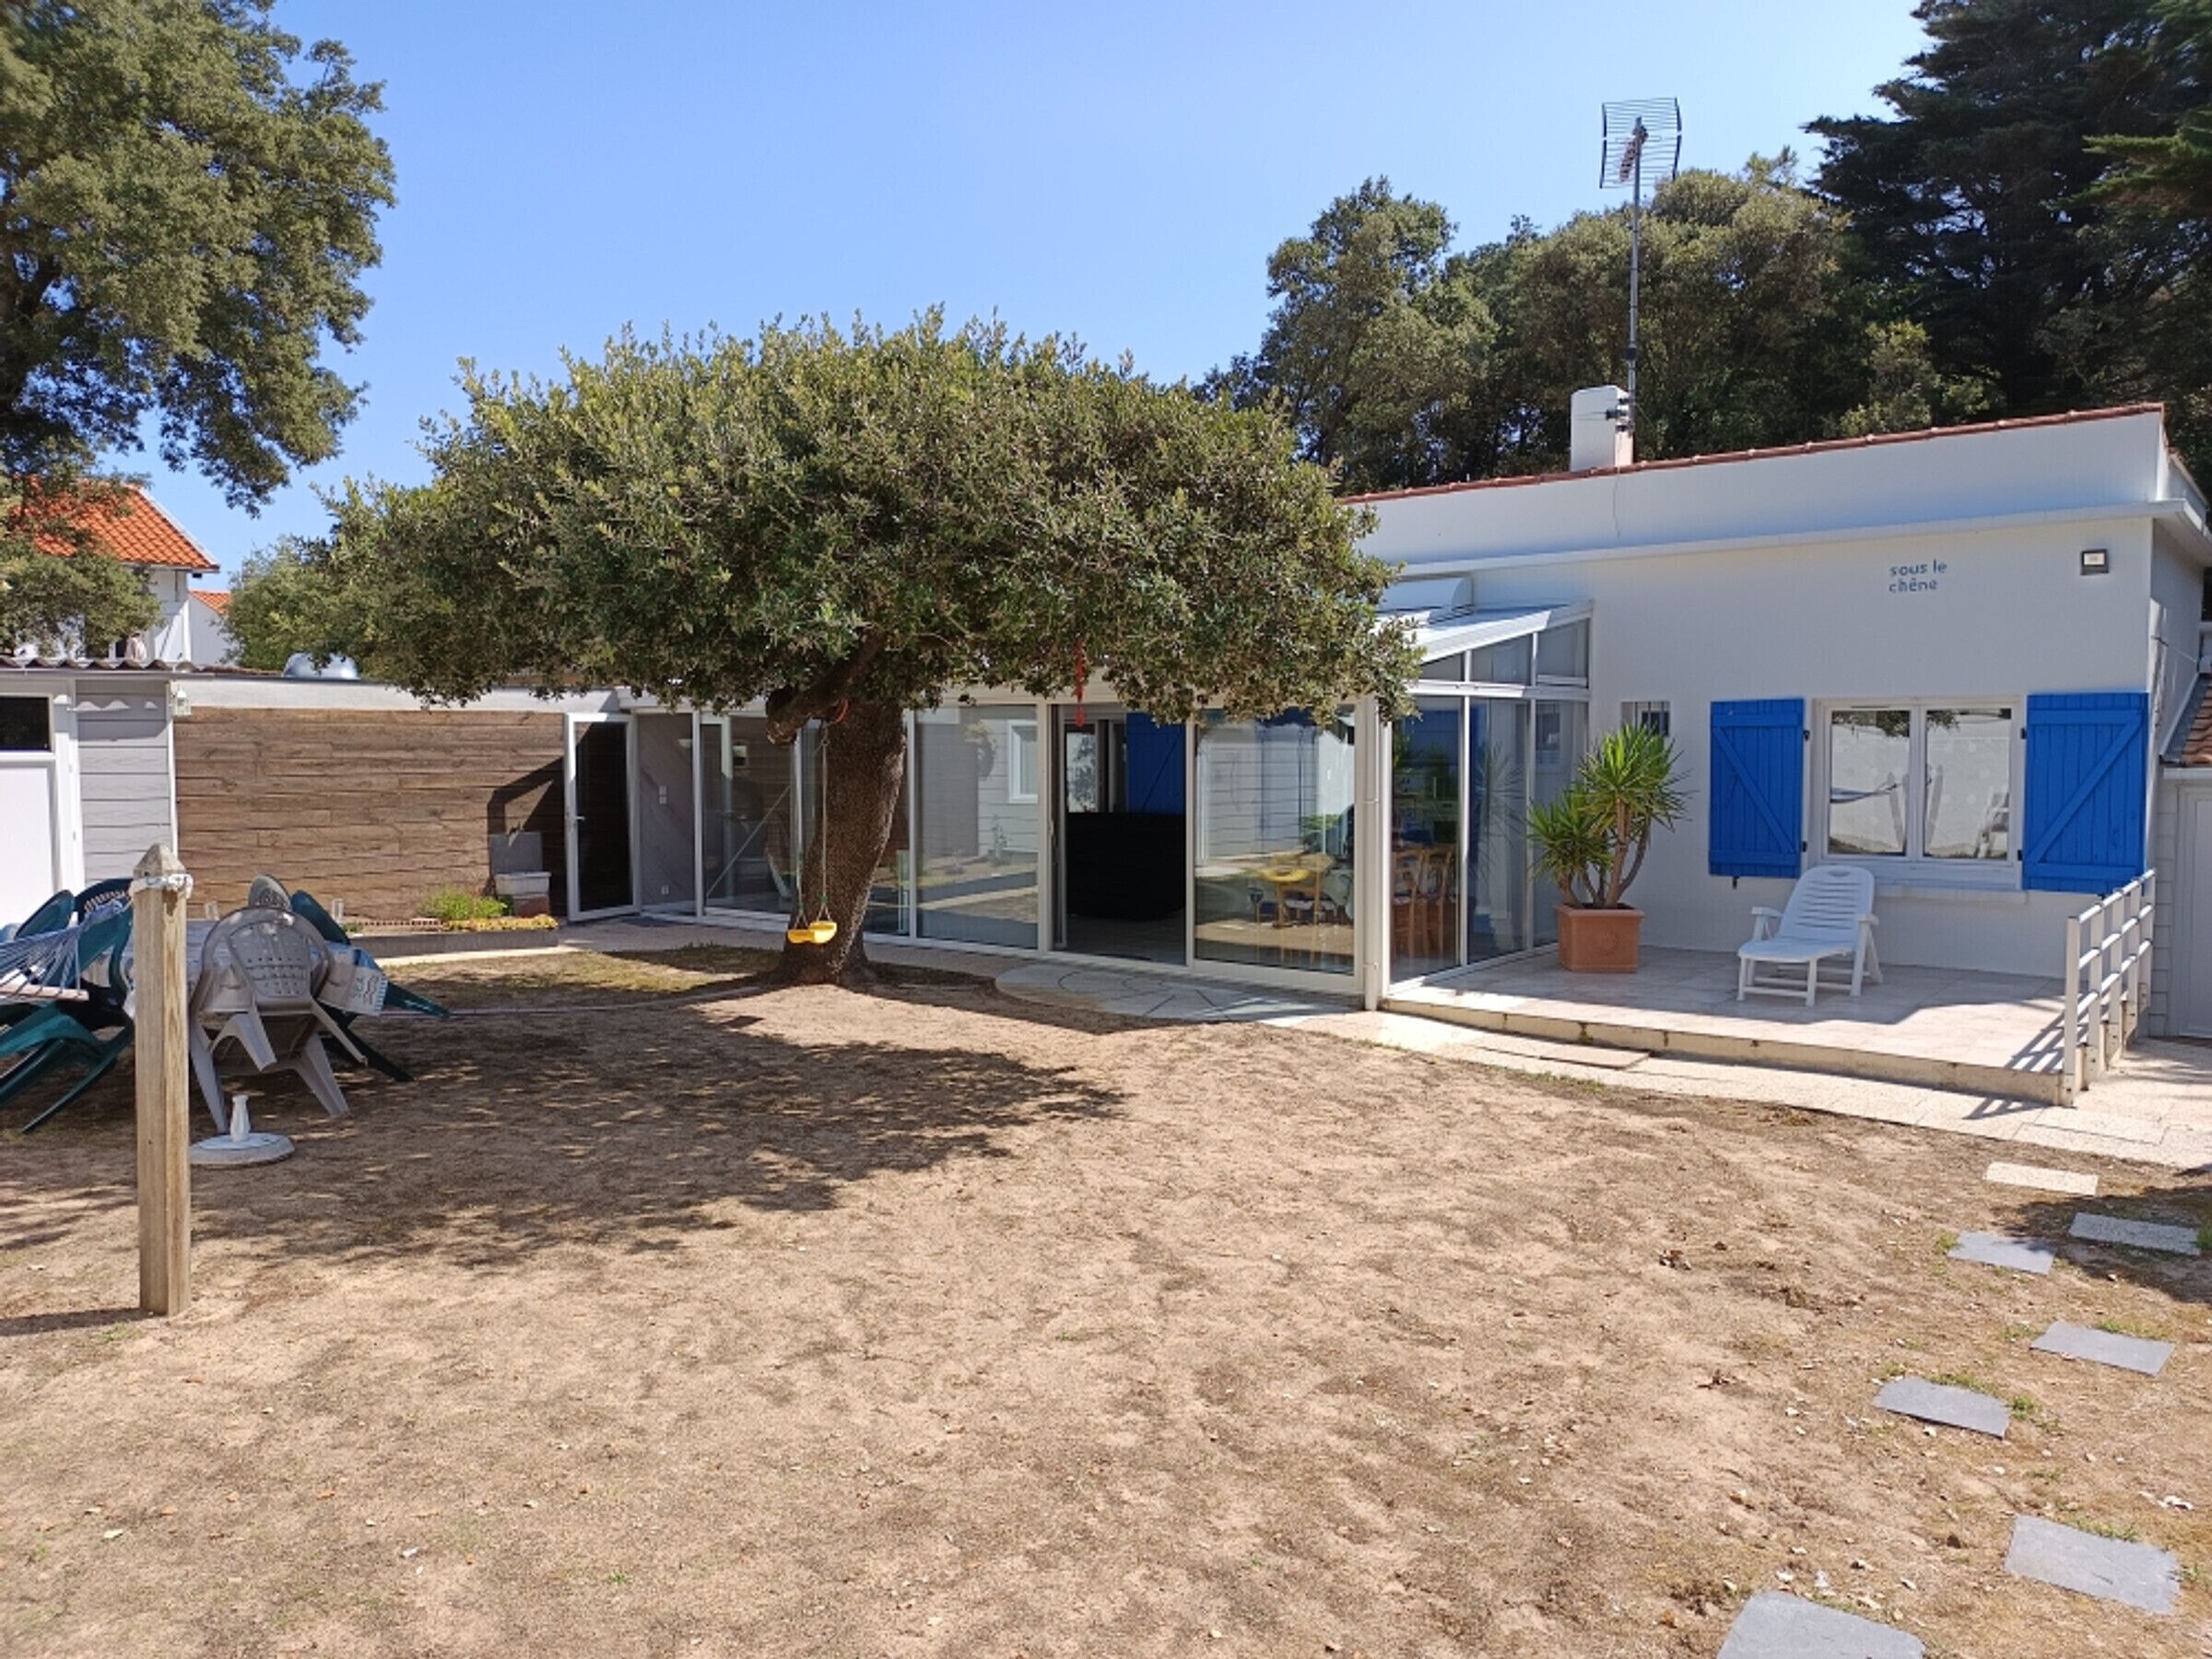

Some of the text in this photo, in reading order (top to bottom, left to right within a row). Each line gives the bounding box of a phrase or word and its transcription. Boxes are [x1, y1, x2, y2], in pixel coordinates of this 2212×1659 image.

[1888, 559, 1947, 577] sous le
[1888, 577, 1937, 593] chêne
